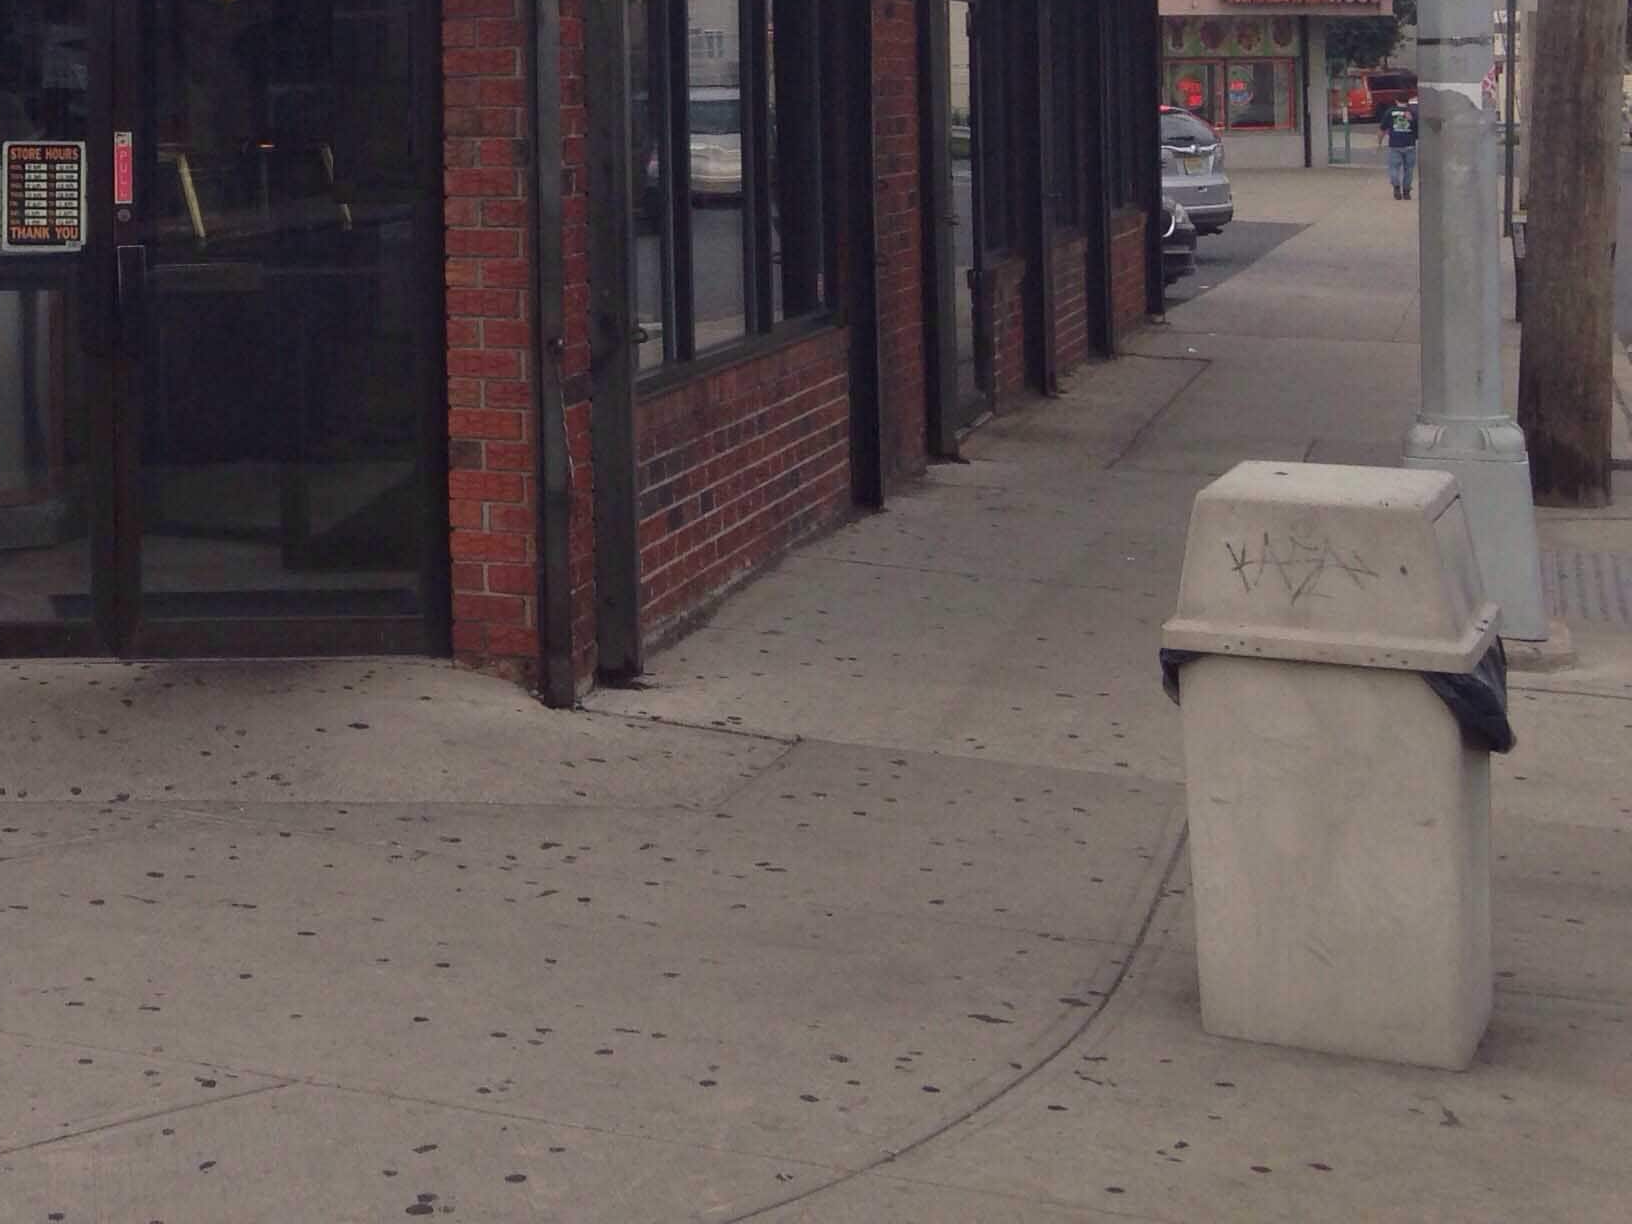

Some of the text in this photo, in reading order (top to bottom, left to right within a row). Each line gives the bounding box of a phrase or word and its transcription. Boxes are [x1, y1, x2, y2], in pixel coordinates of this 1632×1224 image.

[9, 146, 79, 161] STORE HOURS
[9, 226, 79, 240] THANK YOU
